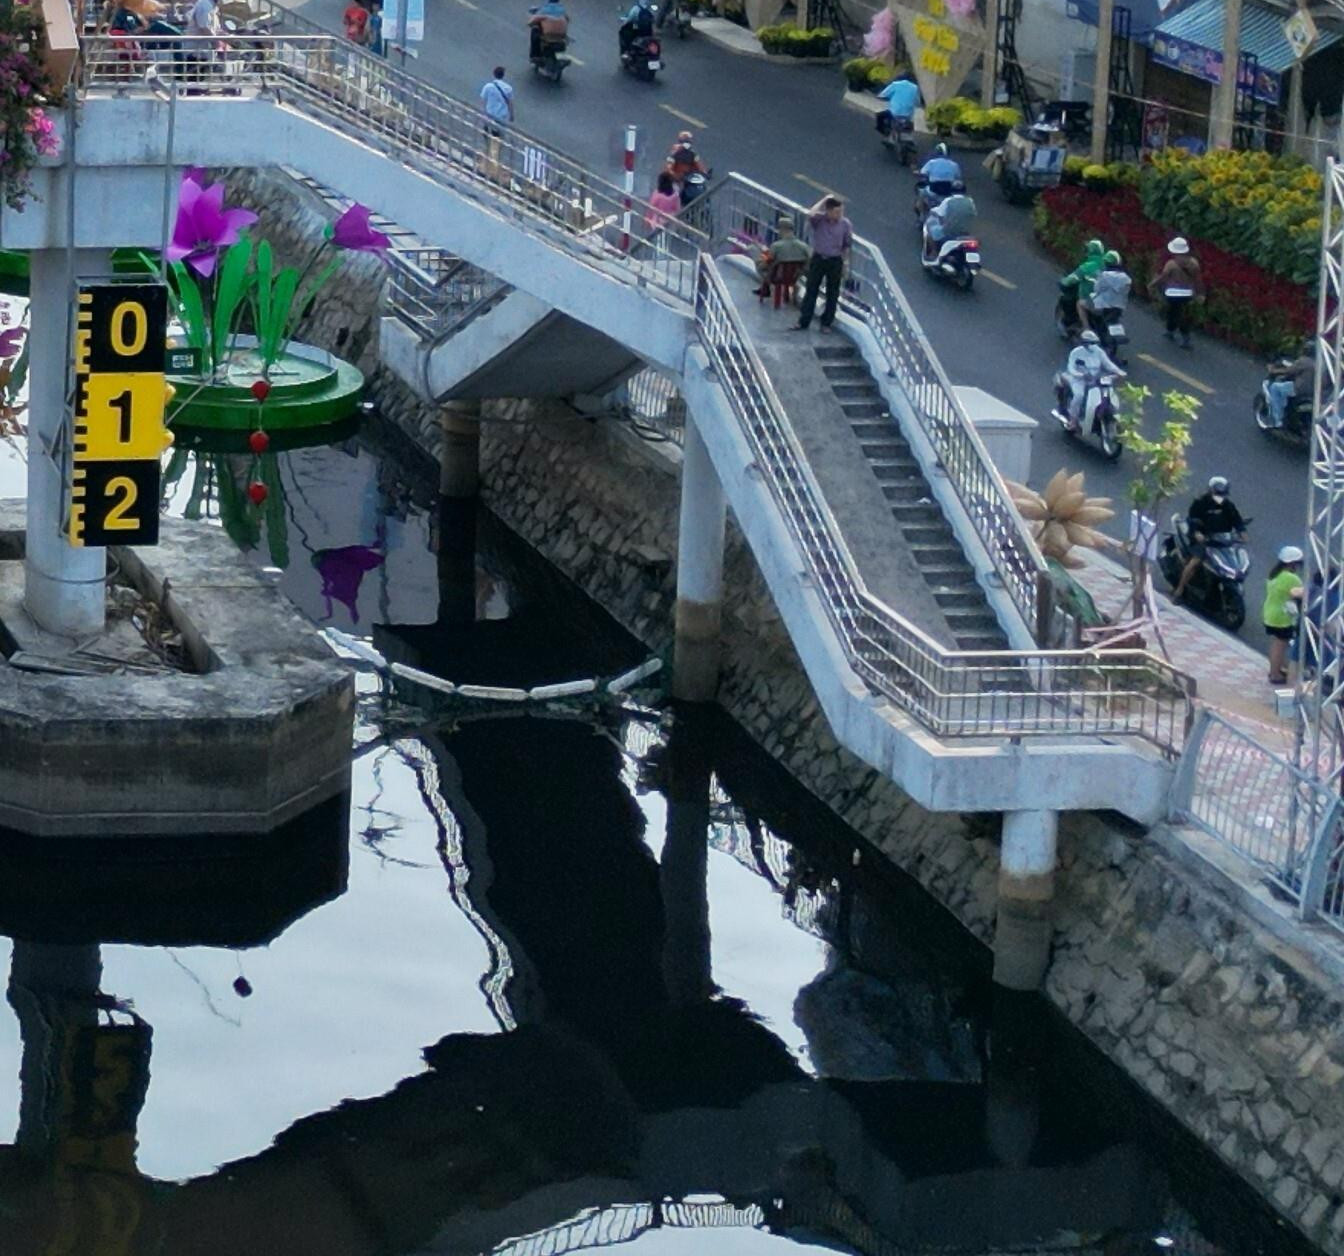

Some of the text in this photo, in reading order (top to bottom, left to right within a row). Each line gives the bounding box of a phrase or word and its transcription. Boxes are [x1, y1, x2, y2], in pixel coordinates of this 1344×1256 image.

[110, 300, 149, 357] 0
[108, 390, 134, 444] 1
[102, 476, 141, 531] 2
